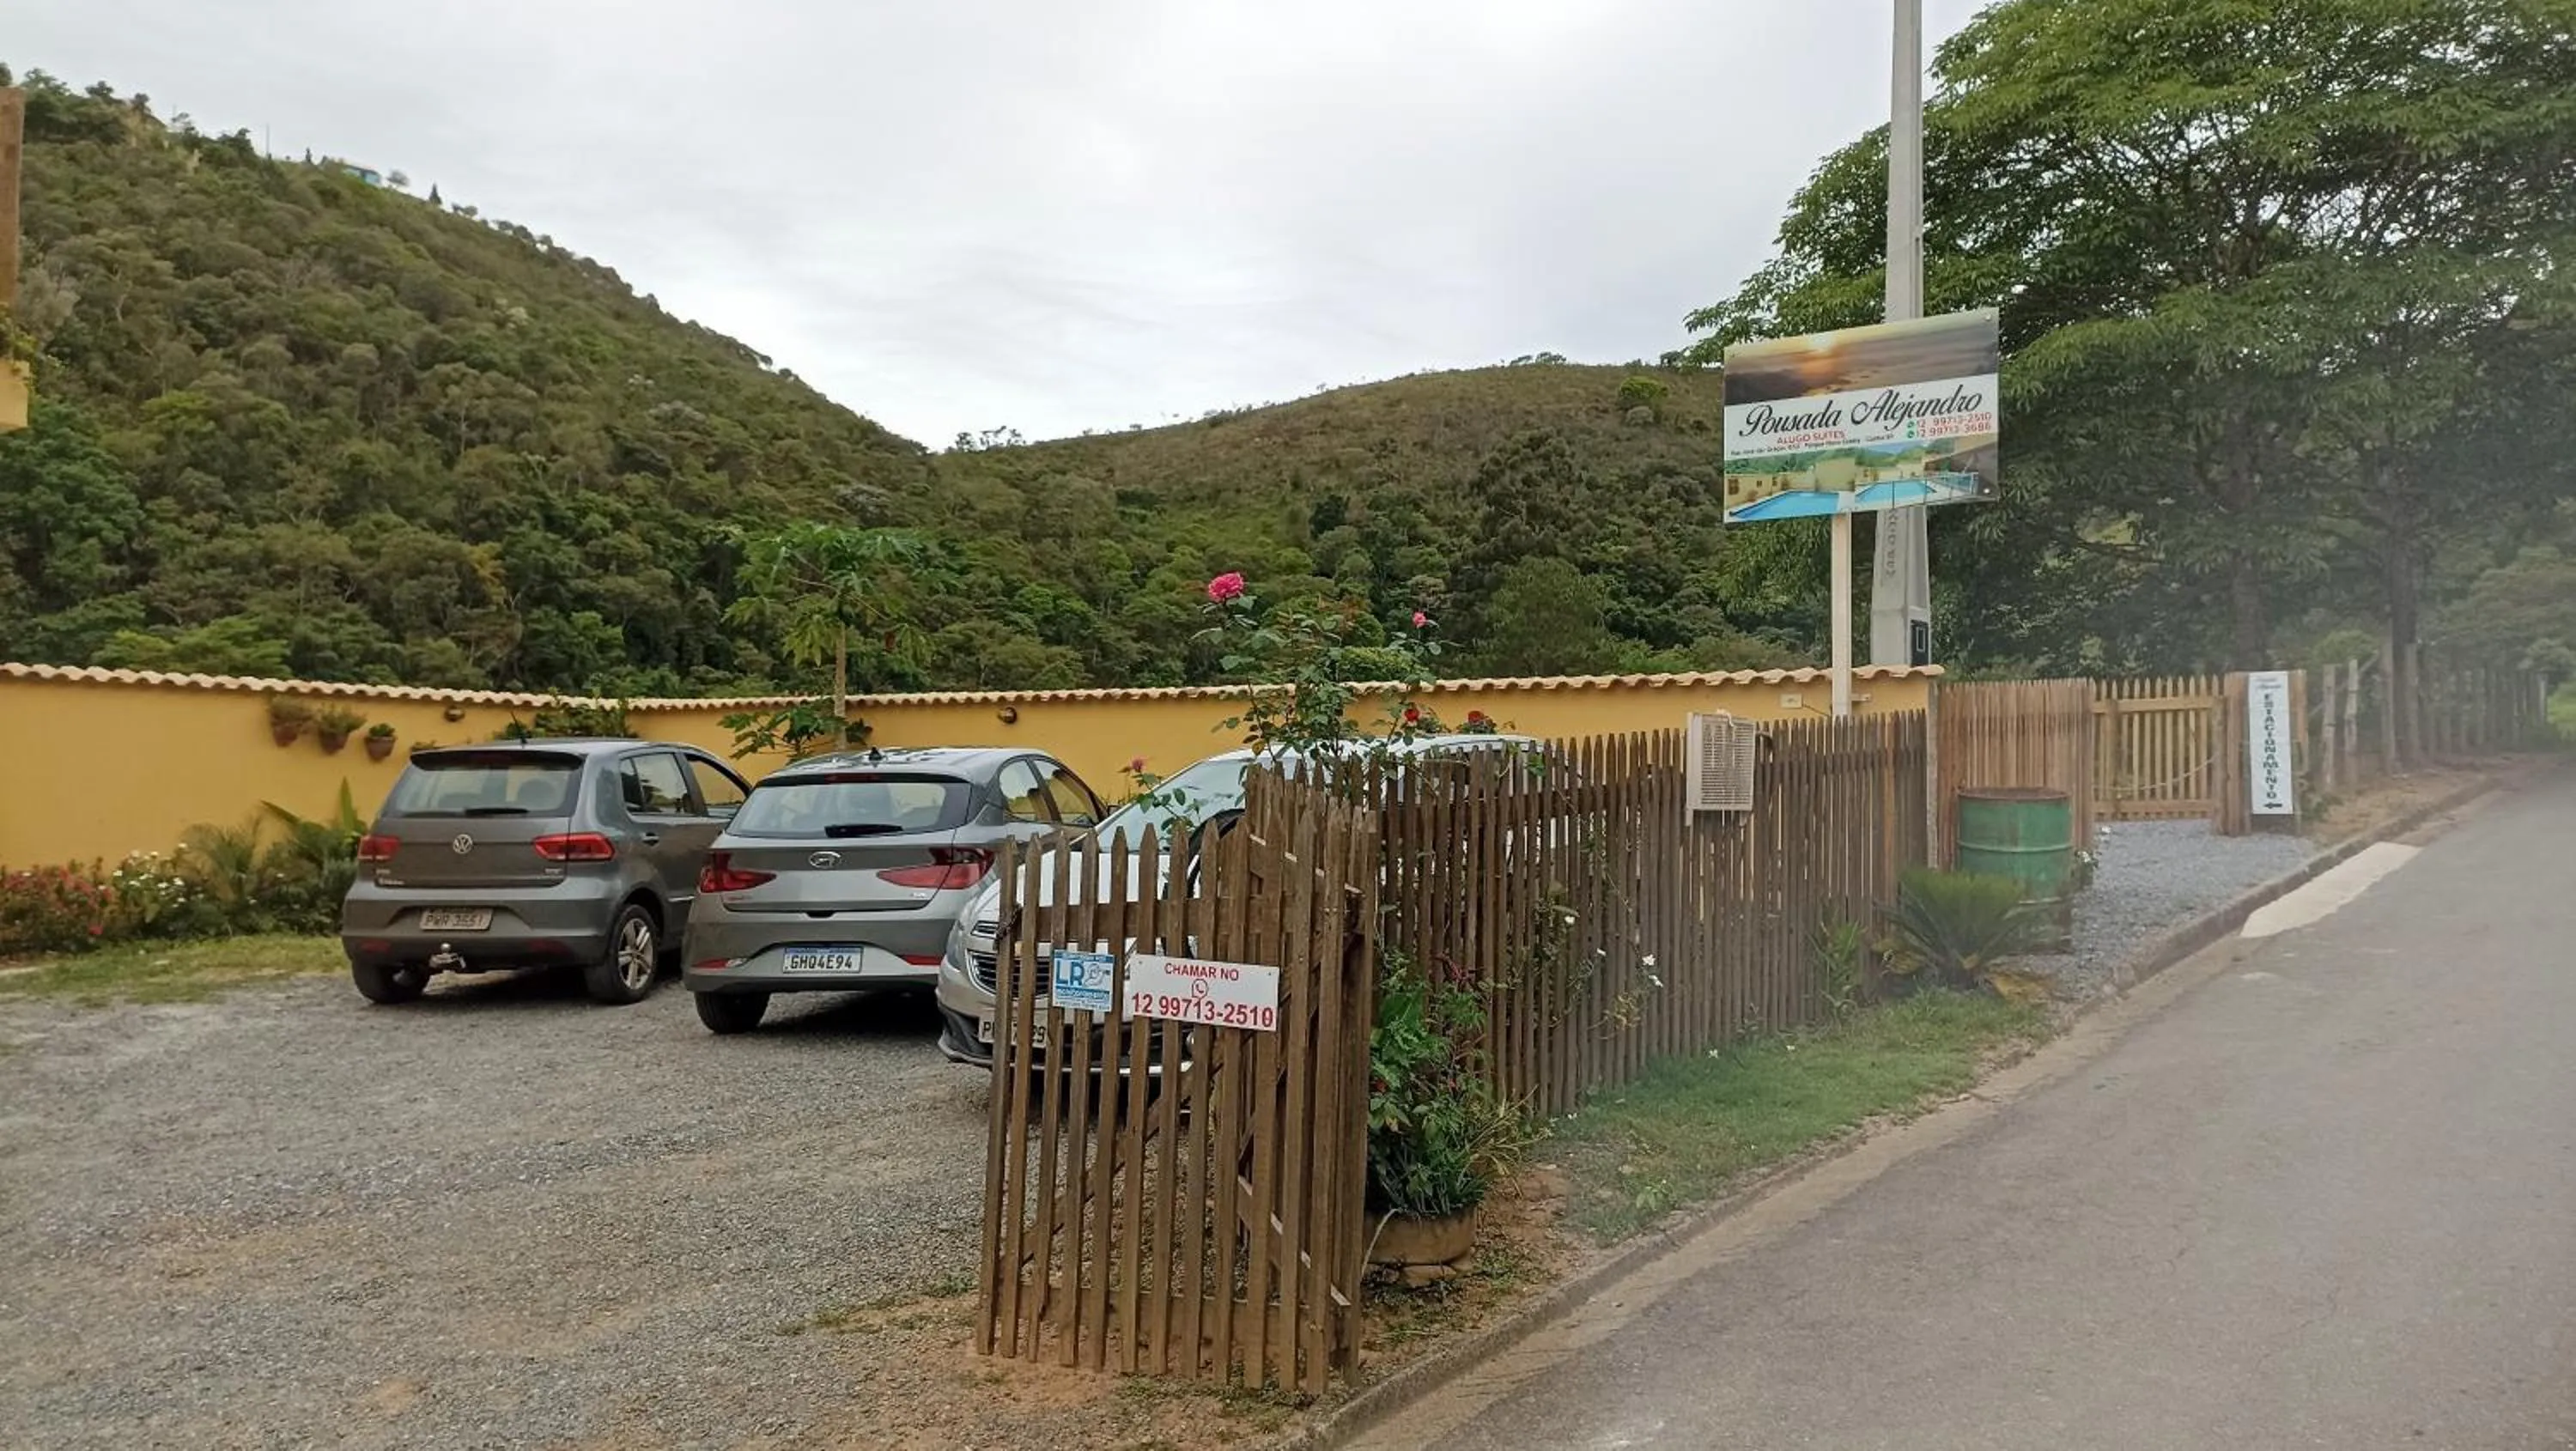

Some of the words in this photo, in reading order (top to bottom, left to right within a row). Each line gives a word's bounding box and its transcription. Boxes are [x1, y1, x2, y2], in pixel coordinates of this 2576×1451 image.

[1739, 400, 1842, 436] Pousada
[1851, 385, 1983, 429] Alejandro
[1777, 432, 1811, 444] ALUGO
[1813, 429, 1846, 441] SUITES
[2263, 693, 2279, 799] ESTACIONAMENTO
[1056, 960, 1084, 987] LR
[1164, 962, 1217, 979] CHAMAR
[1220, 968, 1239, 981] NO
[1131, 993, 1153, 1014] 12
[1159, 995, 1274, 1028] 99713-2510
